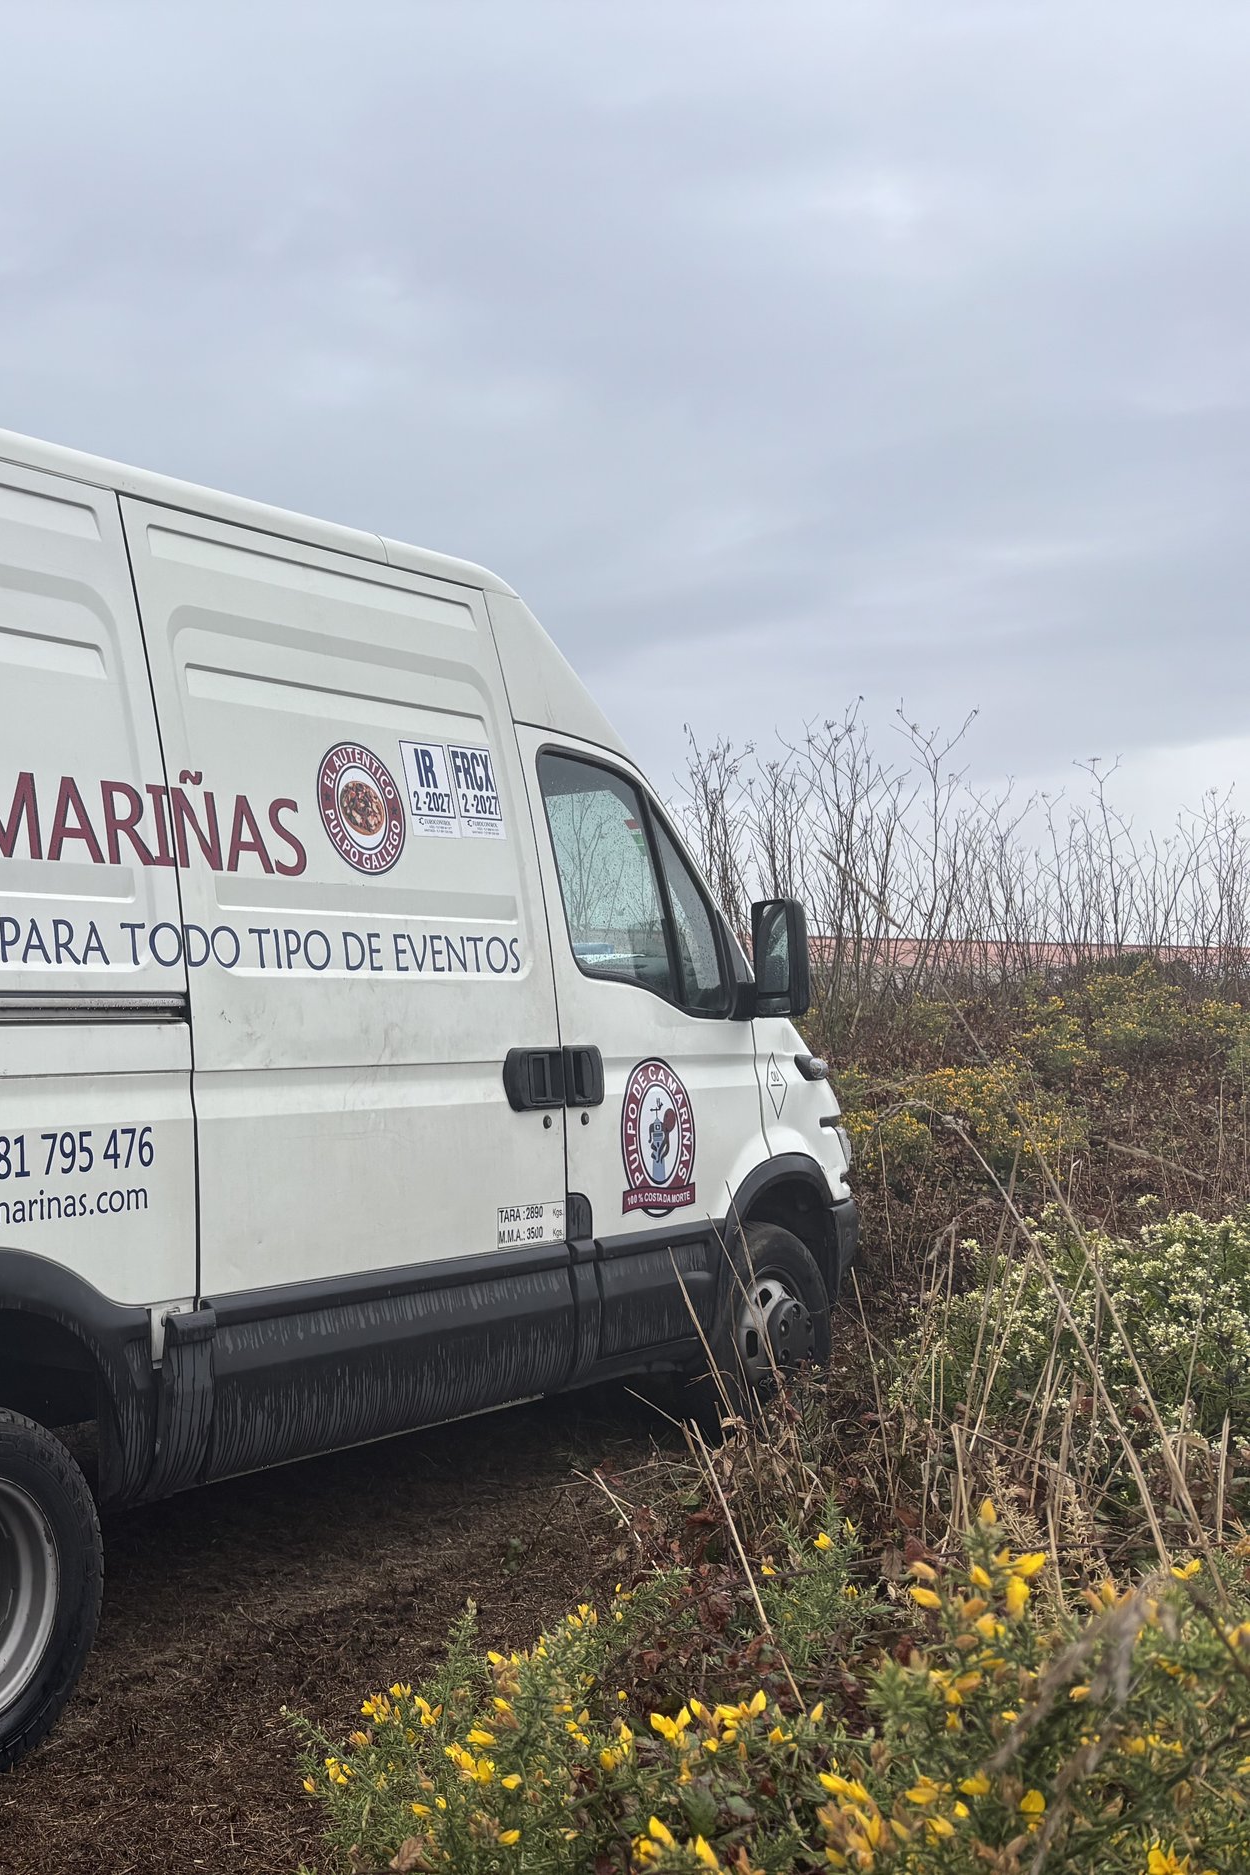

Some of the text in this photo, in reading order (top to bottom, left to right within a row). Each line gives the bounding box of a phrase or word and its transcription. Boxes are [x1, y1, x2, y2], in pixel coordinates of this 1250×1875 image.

[324, 748, 394, 799] EL AUTENTICO
[413, 747, 439, 789] IR
[451, 750, 495, 792] FRCX
[325, 808, 401, 869] PULPO GALLEGO
[120, 922, 240, 968] TODO
[248, 928, 331, 971] TIPO
[342, 931, 383, 971] DE
[393, 933, 521, 973] EVENTOS
[627, 1066, 692, 1187] PULPO DE CAMARIÑAS
[40, 1130, 94, 1176] 795
[102, 1126, 154, 1169] 476
[526, 1205, 544, 1220] 2890
[644, 1192, 663, 1203] COSTA
[663, 1194, 671, 1203] DA
[671, 1191, 691, 1203] MORTE
[526, 1225, 544, 1240] 3500
